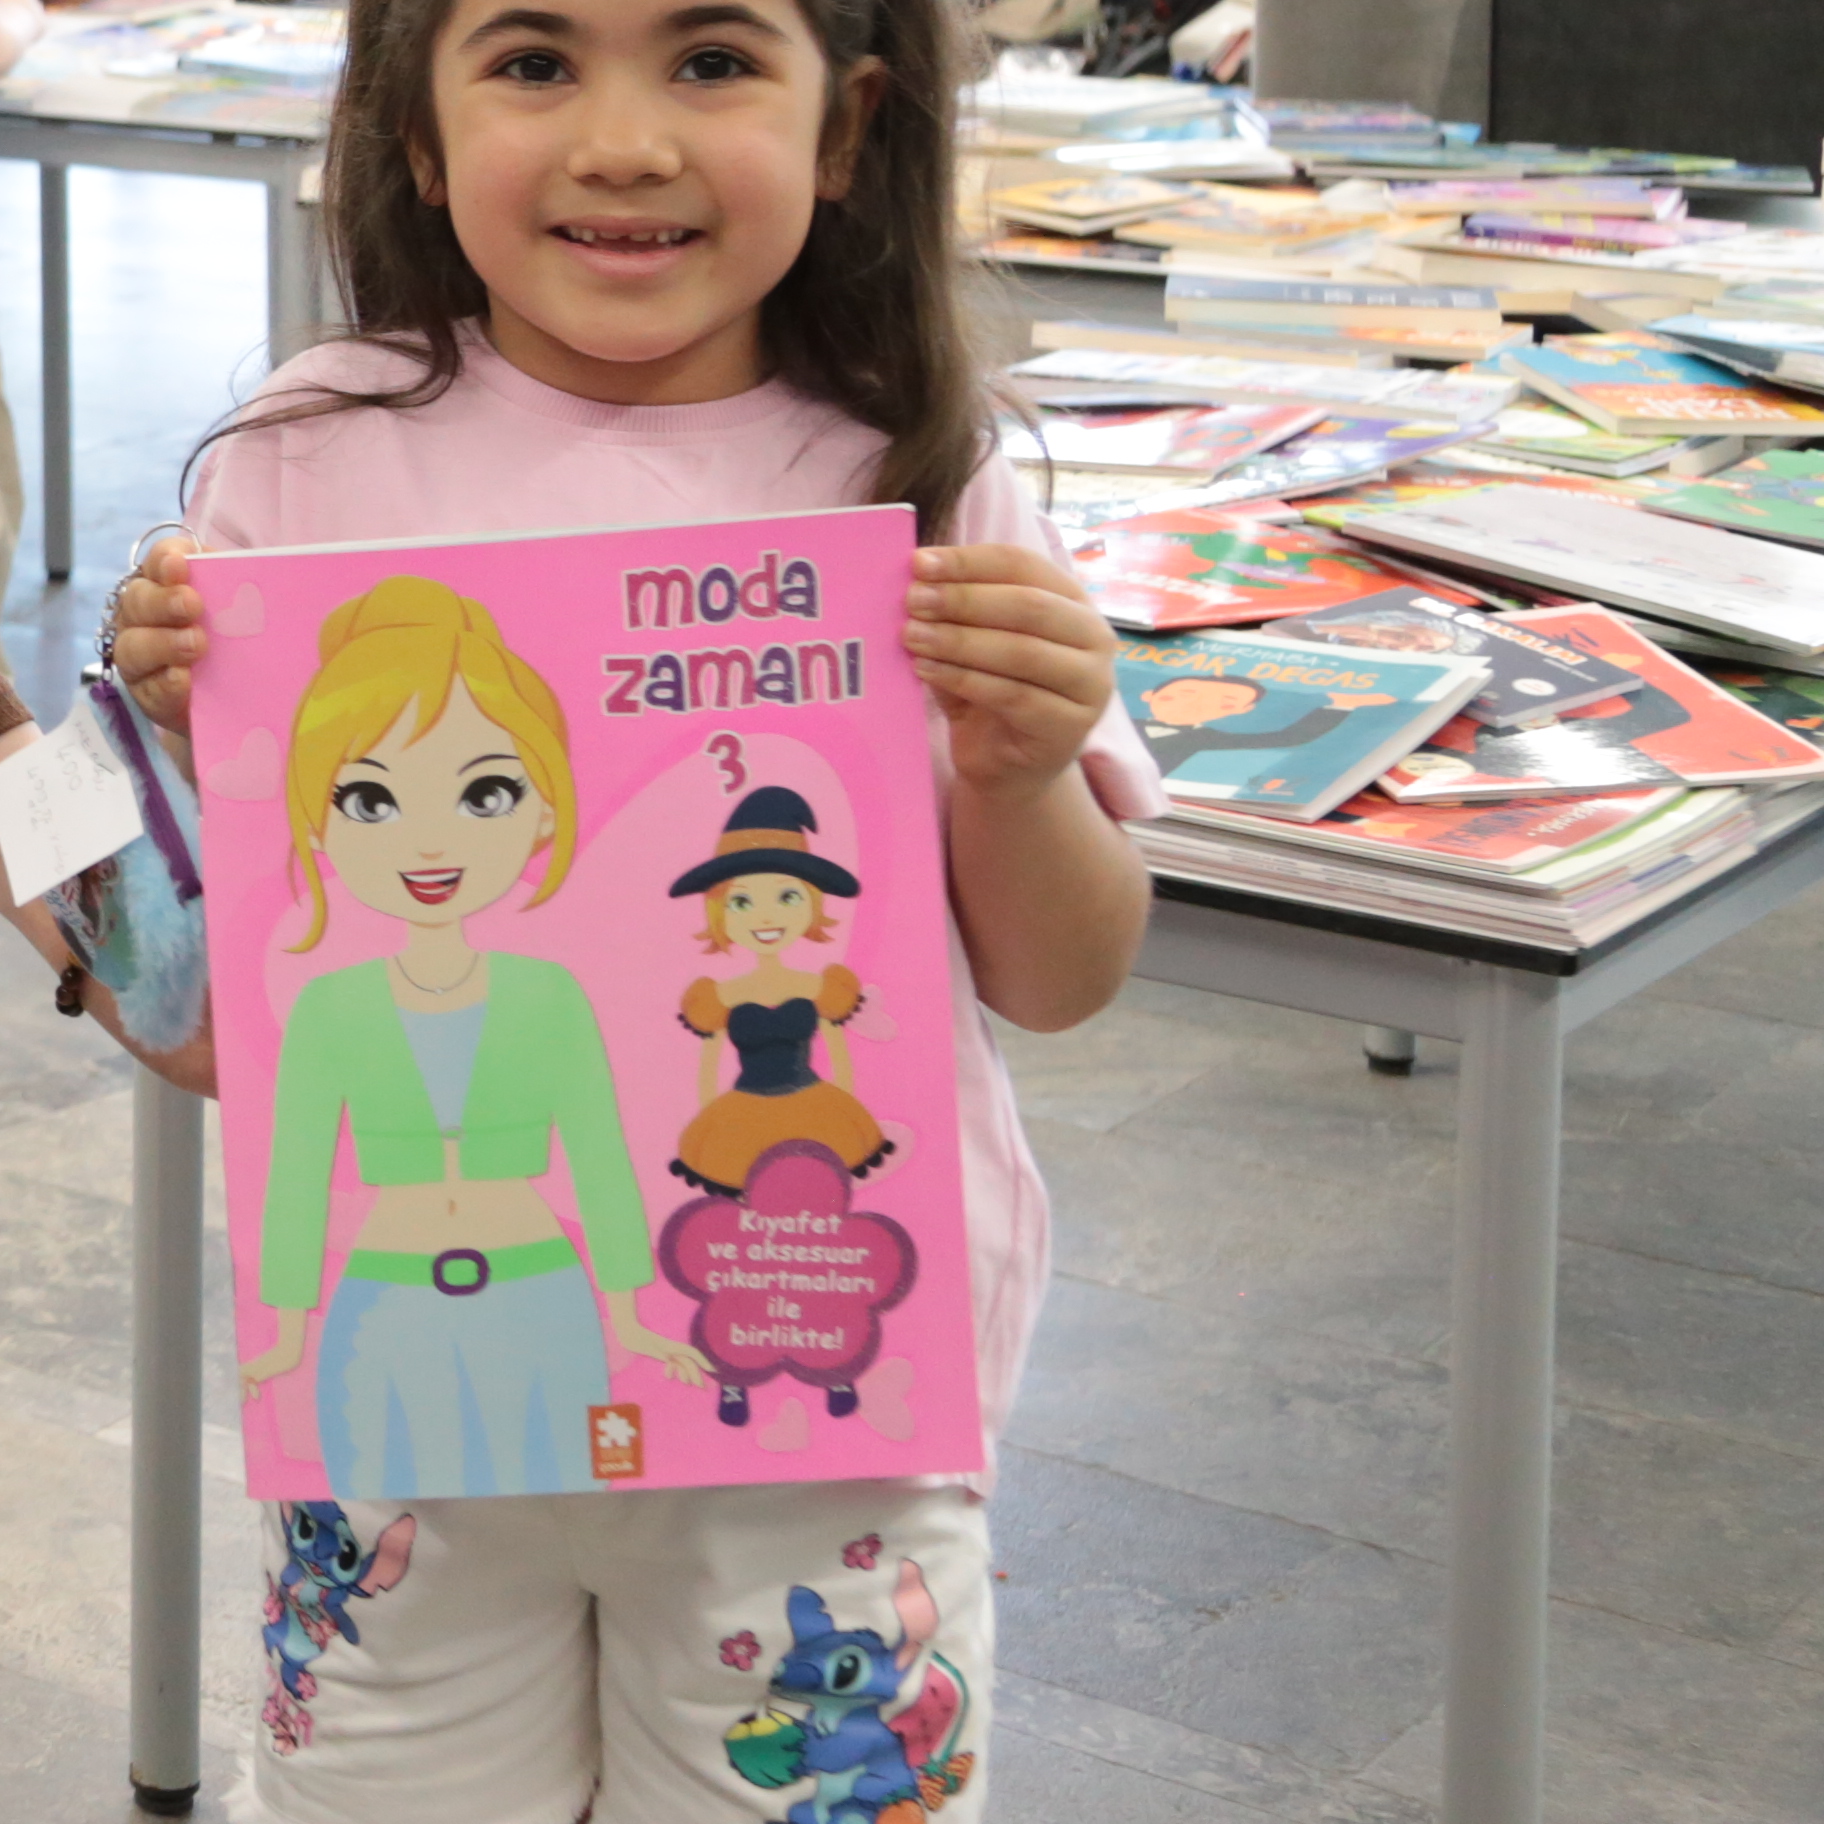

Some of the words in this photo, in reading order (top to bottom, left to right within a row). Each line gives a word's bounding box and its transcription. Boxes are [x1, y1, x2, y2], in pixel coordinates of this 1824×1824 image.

[623, 549, 821, 631] moda
[1191, 640, 1318, 666] MERHABA
[603, 637, 863, 717] zamanı
[1247, 662, 1380, 689] DEGAS
[704, 730, 749, 796] 3
[738, 1208, 842, 1238] Kıyafet
[706, 1241, 739, 1260] ve
[746, 1237, 870, 1264] aksesuar
[705, 1265, 876, 1293] çıkartmaları
[766, 1294, 802, 1320] ile
[729, 1322, 845, 1351] birlikte!
